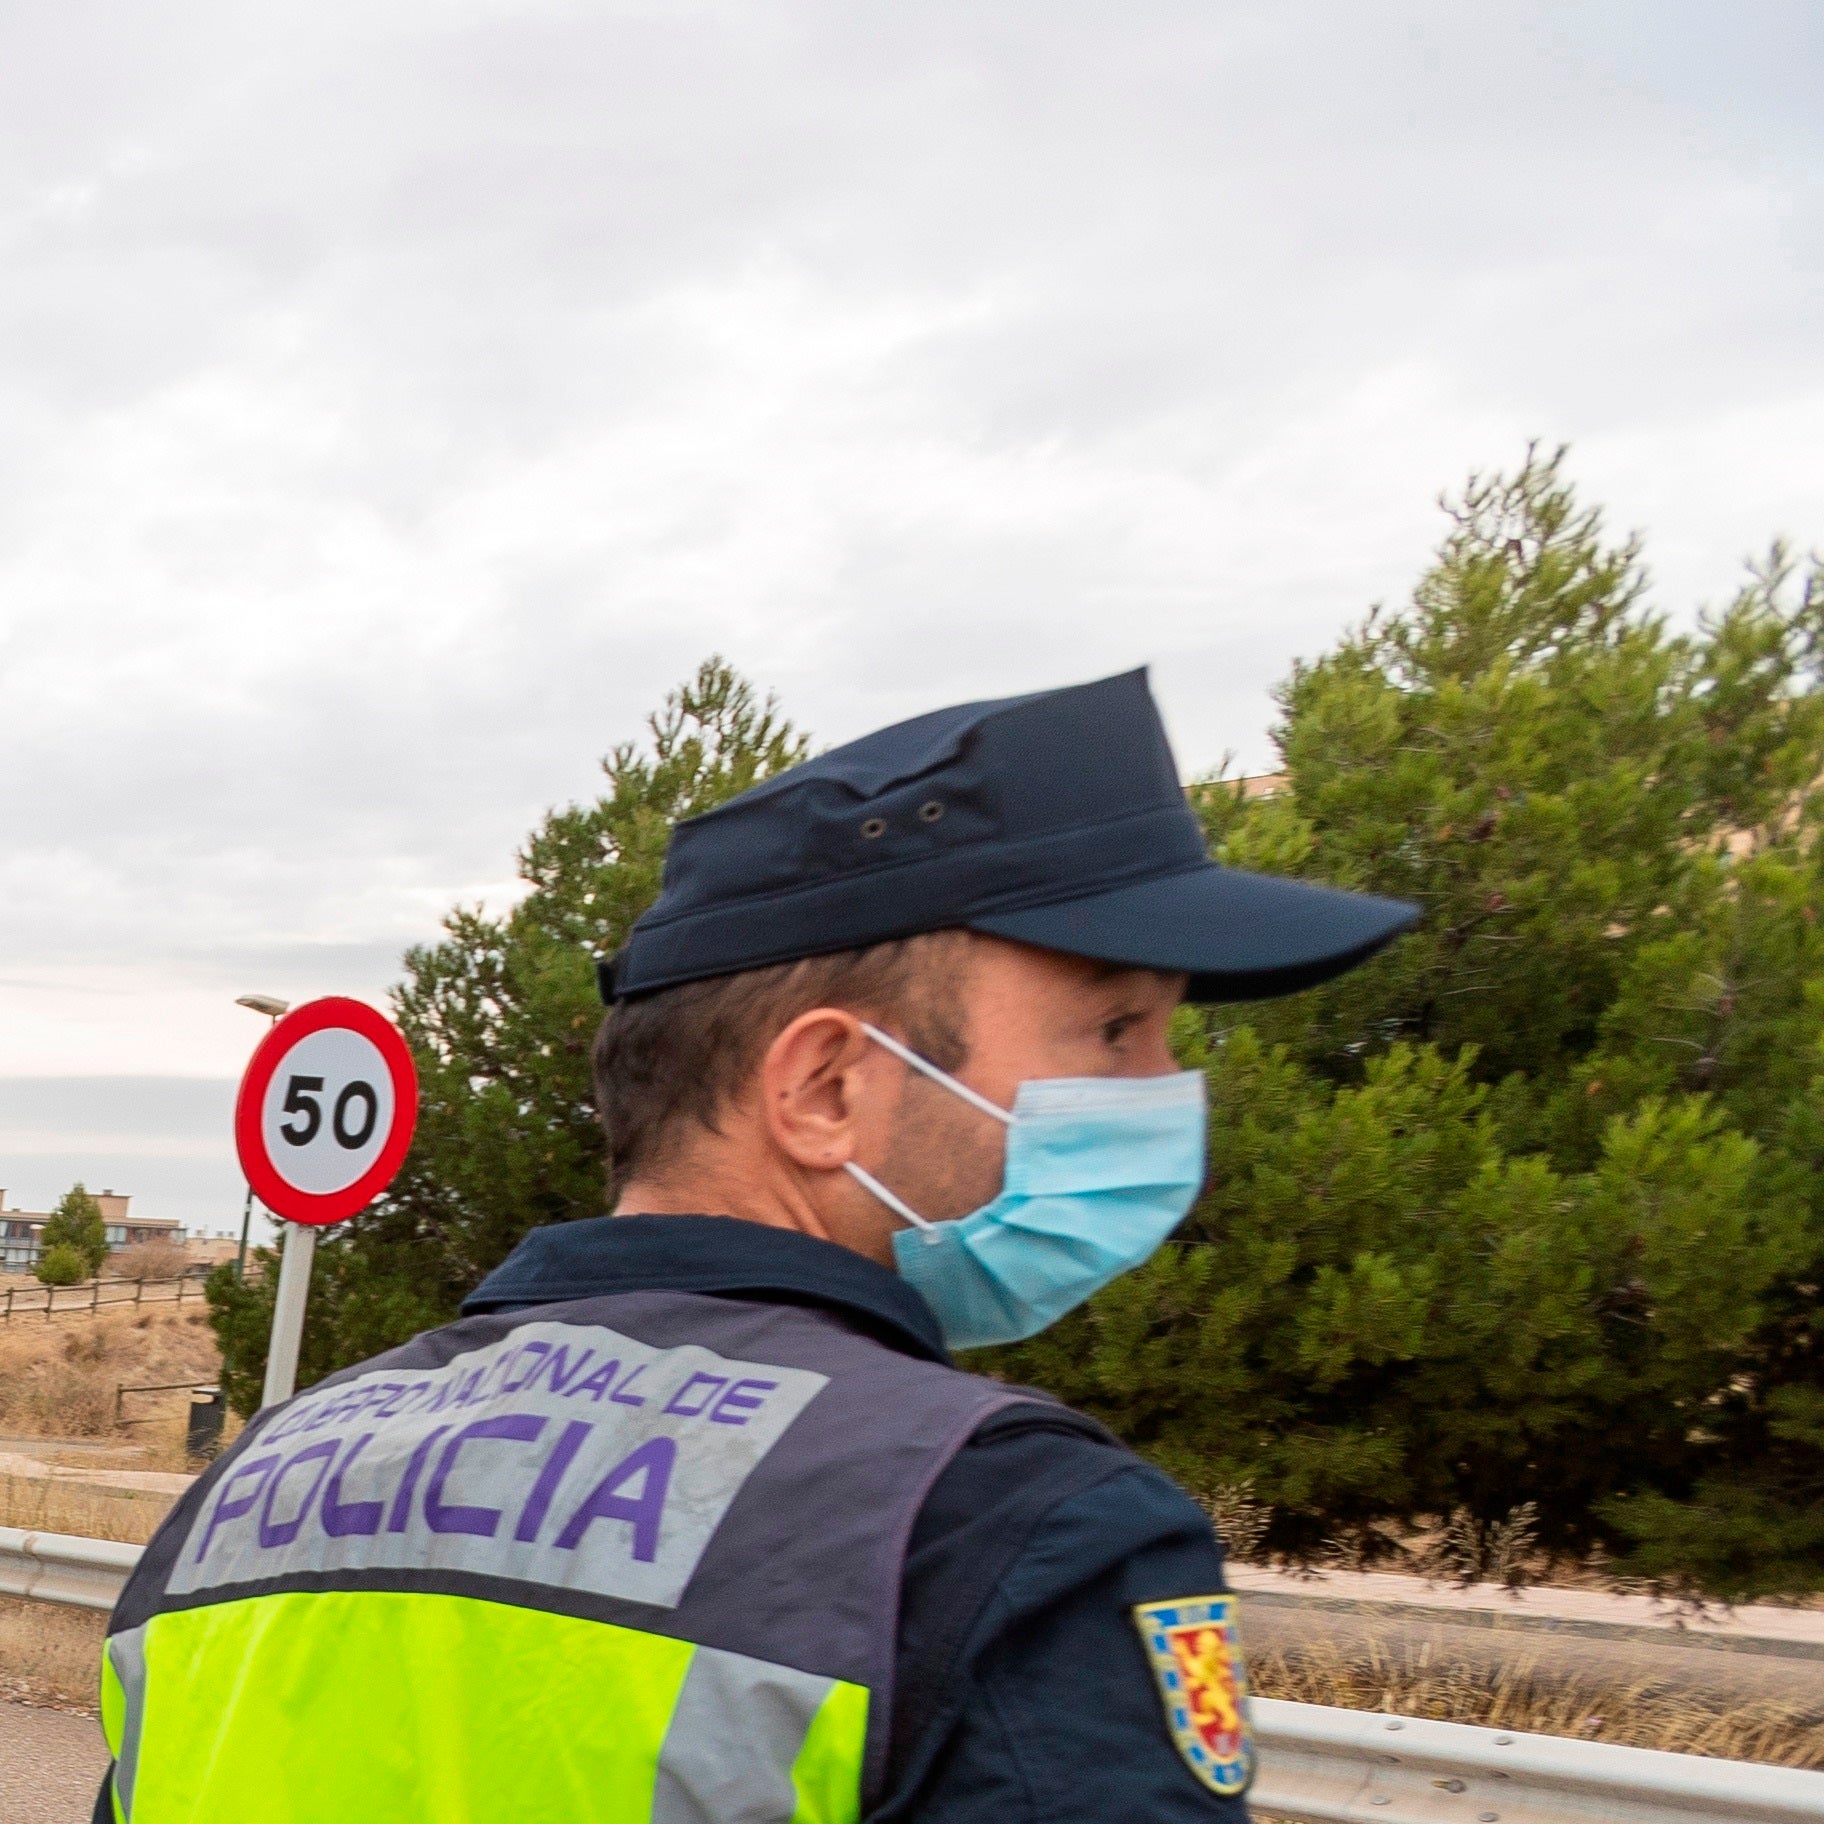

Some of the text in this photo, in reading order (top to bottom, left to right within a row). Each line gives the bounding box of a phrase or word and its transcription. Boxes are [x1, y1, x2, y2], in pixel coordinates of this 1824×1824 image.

[280, 1075, 378, 1150] 50
[262, 1341, 778, 1446] CUERPO NACIONAL DE
[195, 1414, 677, 1564] POLICIA
